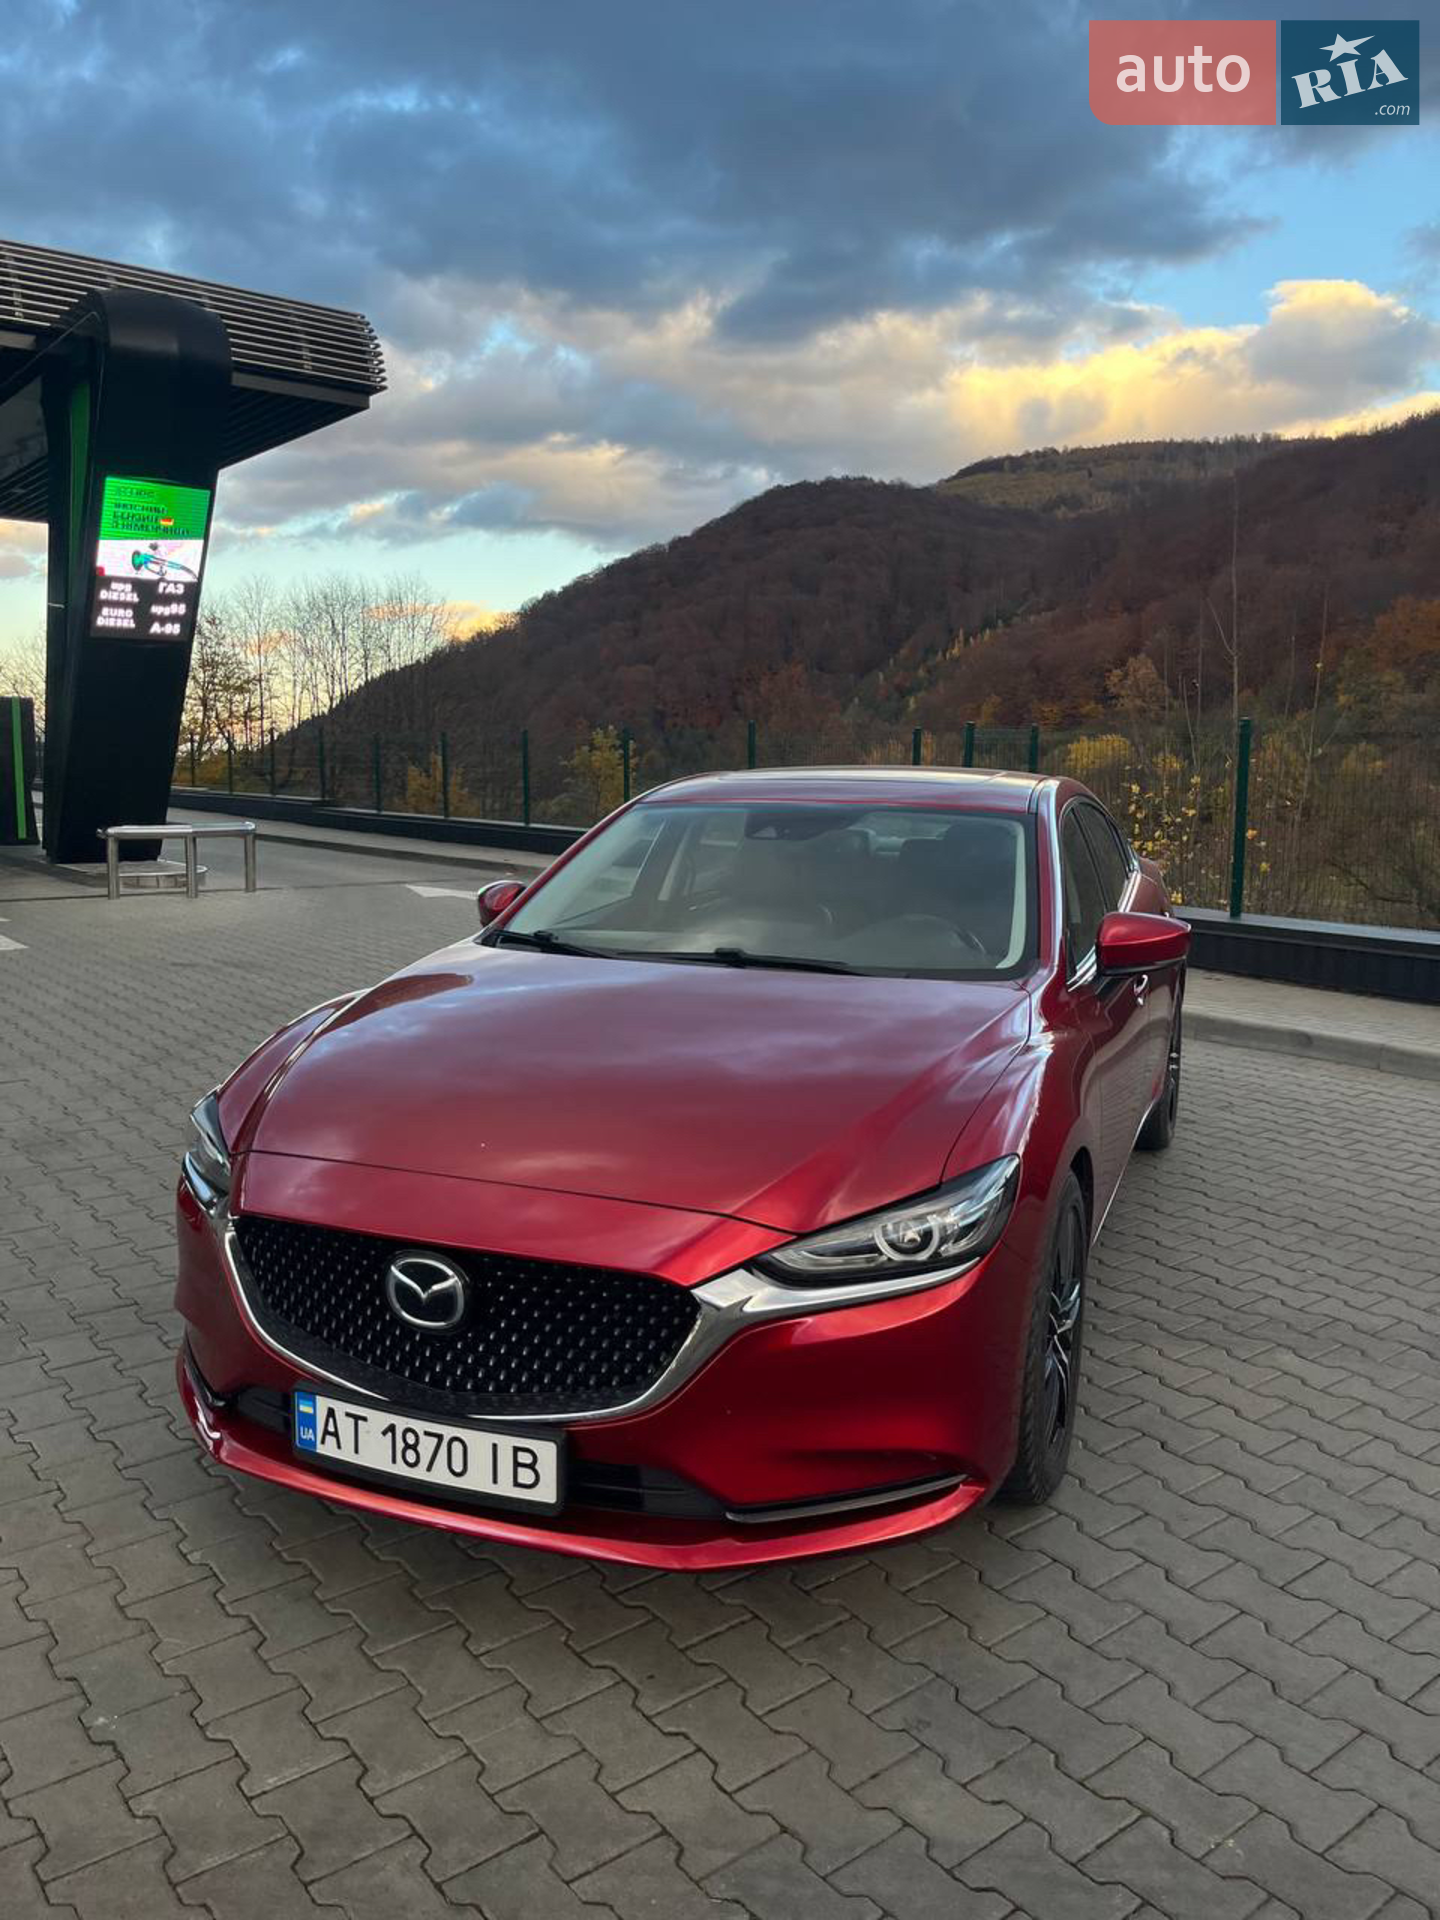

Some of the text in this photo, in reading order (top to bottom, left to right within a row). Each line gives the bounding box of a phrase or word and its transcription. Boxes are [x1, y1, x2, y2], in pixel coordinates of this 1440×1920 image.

[99, 590, 140, 602] DIESEL
[102, 607, 133, 617] EURO
[96, 617, 136, 628] DIESEL
[300, 1426, 315, 1442] UA
[320, 1406, 541, 1490] AT 1870 IB
